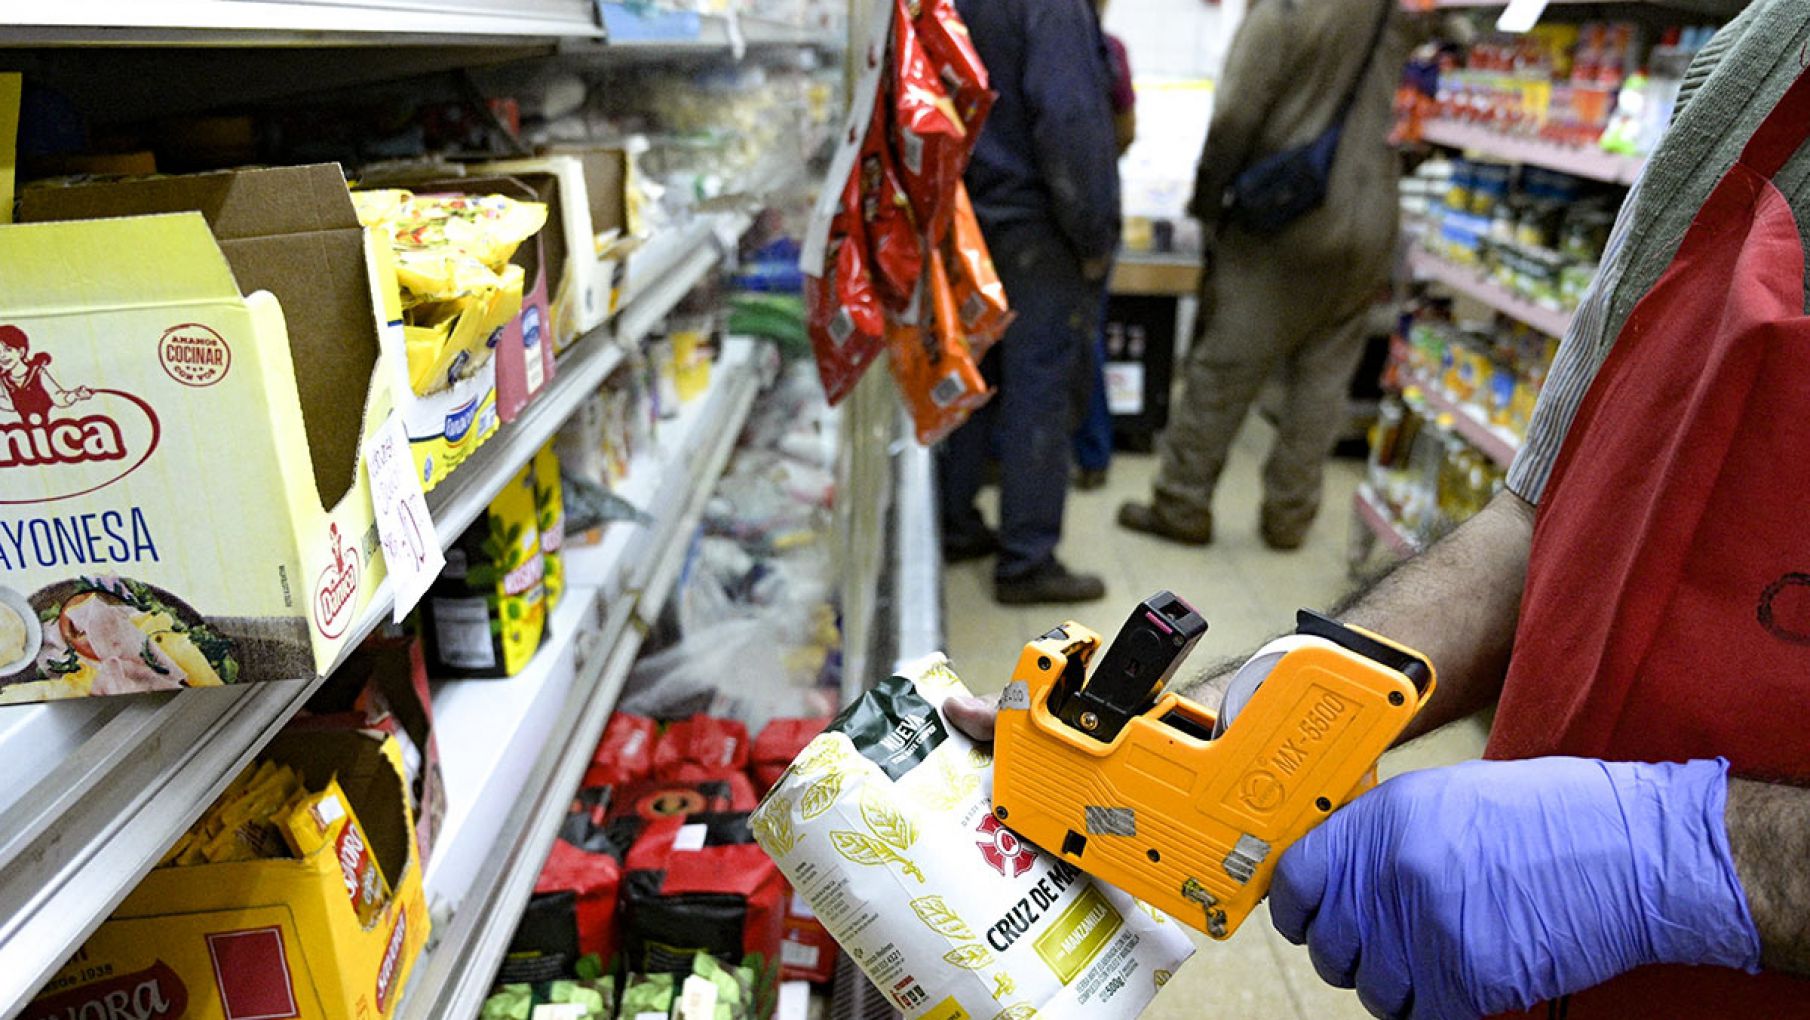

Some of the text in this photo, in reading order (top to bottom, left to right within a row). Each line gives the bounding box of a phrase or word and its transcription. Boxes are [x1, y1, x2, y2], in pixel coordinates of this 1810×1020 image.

[166, 343, 223, 365] COCINAR
[880, 714, 926, 752] NUEVA
[986, 898, 1039, 952] CRUZ
[1028, 877, 1059, 912] DE
[1061, 903, 1108, 955] MANZANILLA
